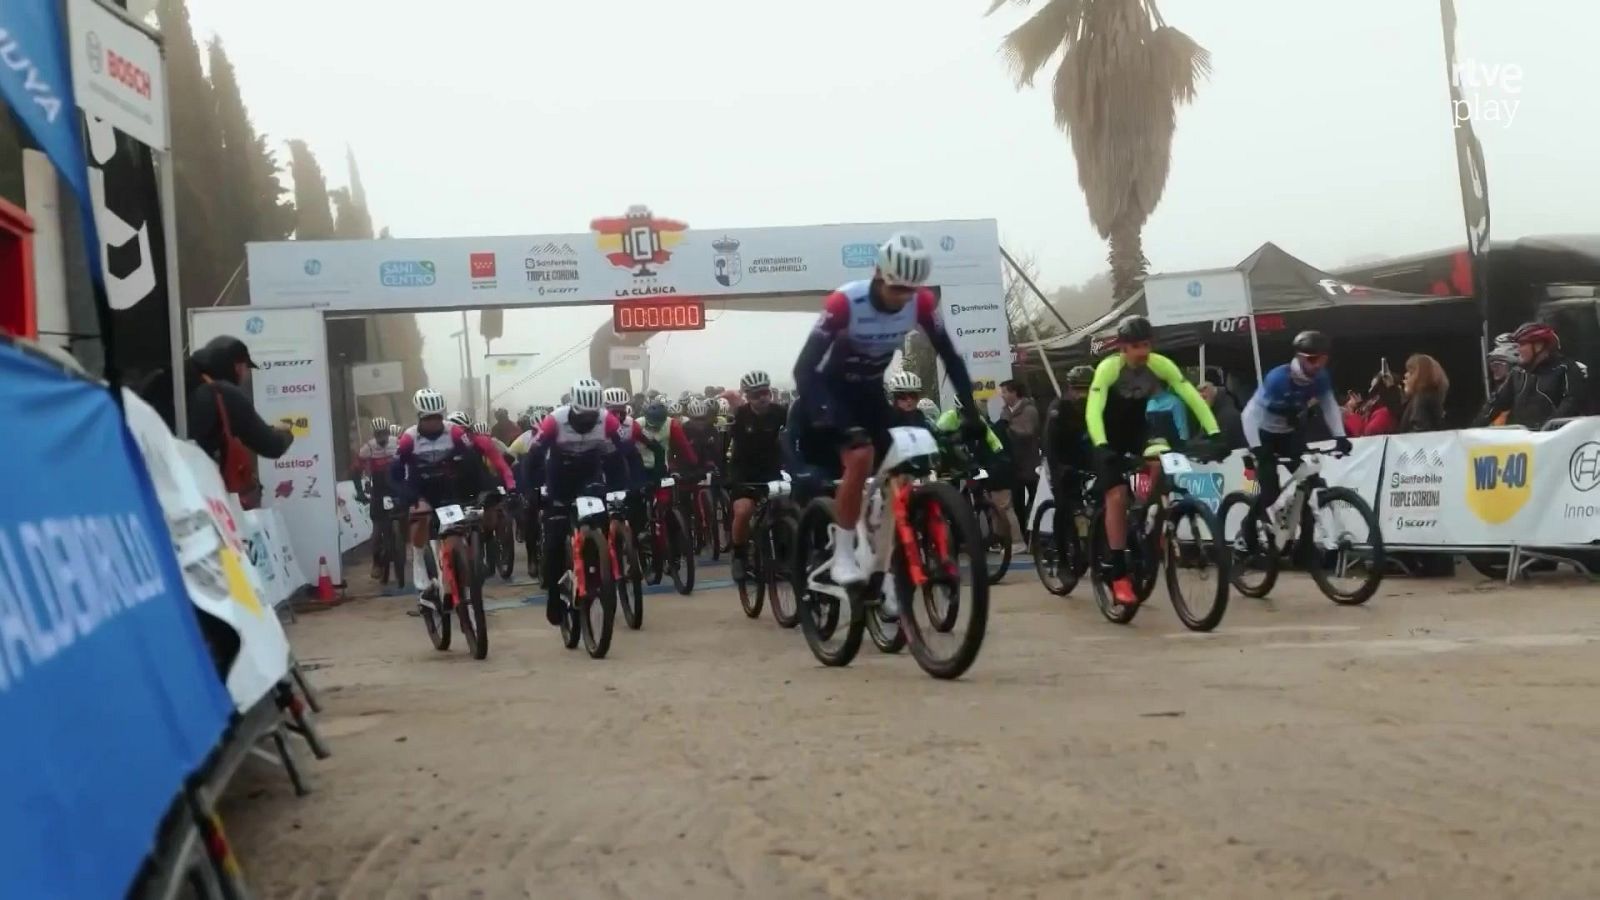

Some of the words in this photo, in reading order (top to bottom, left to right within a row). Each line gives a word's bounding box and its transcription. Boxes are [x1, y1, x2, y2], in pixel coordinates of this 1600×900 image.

[0, 28, 61, 123] UYA
[107, 48, 151, 101] BOSCH
[383, 263, 413, 274] SANI
[383, 274, 434, 286] CENTRO
[526, 271, 551, 281] TRIPLE
[552, 269, 579, 281] CORONA
[615, 289, 629, 297] LA
[632, 286, 677, 296] CLÁSICA
[973, 350, 1000, 358] BOSCH
[281, 384, 315, 393] BOSCH
[275, 460, 313, 470] lastlap
[1473, 453, 1528, 491] WD-40
[1390, 491, 1410, 508] TRIPLE
[1411, 490, 1440, 507] CORONA
[1404, 519, 1437, 528] SCOTT
